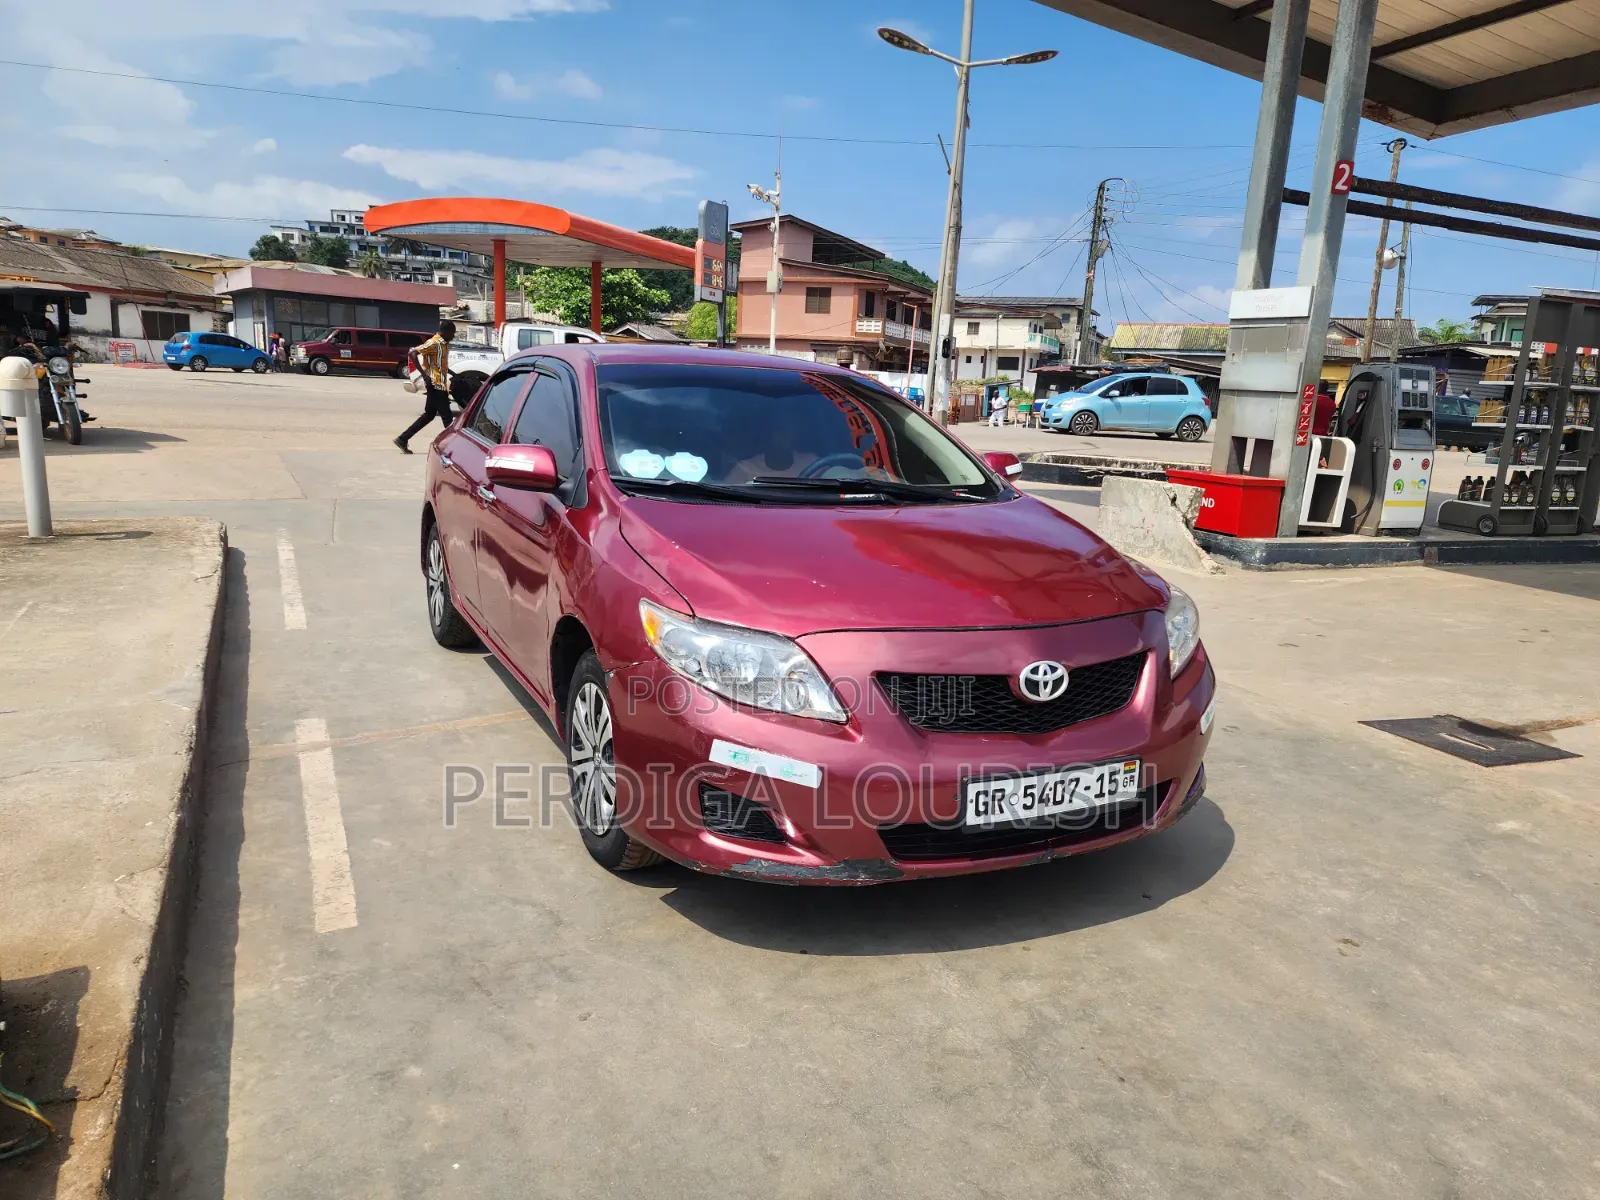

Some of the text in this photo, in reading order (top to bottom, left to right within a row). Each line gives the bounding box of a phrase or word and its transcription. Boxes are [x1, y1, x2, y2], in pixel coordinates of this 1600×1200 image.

[1335, 163, 1350, 190] 2
[1201, 497, 1215, 508] ND
[974, 769, 1120, 817] GR 5407-15
